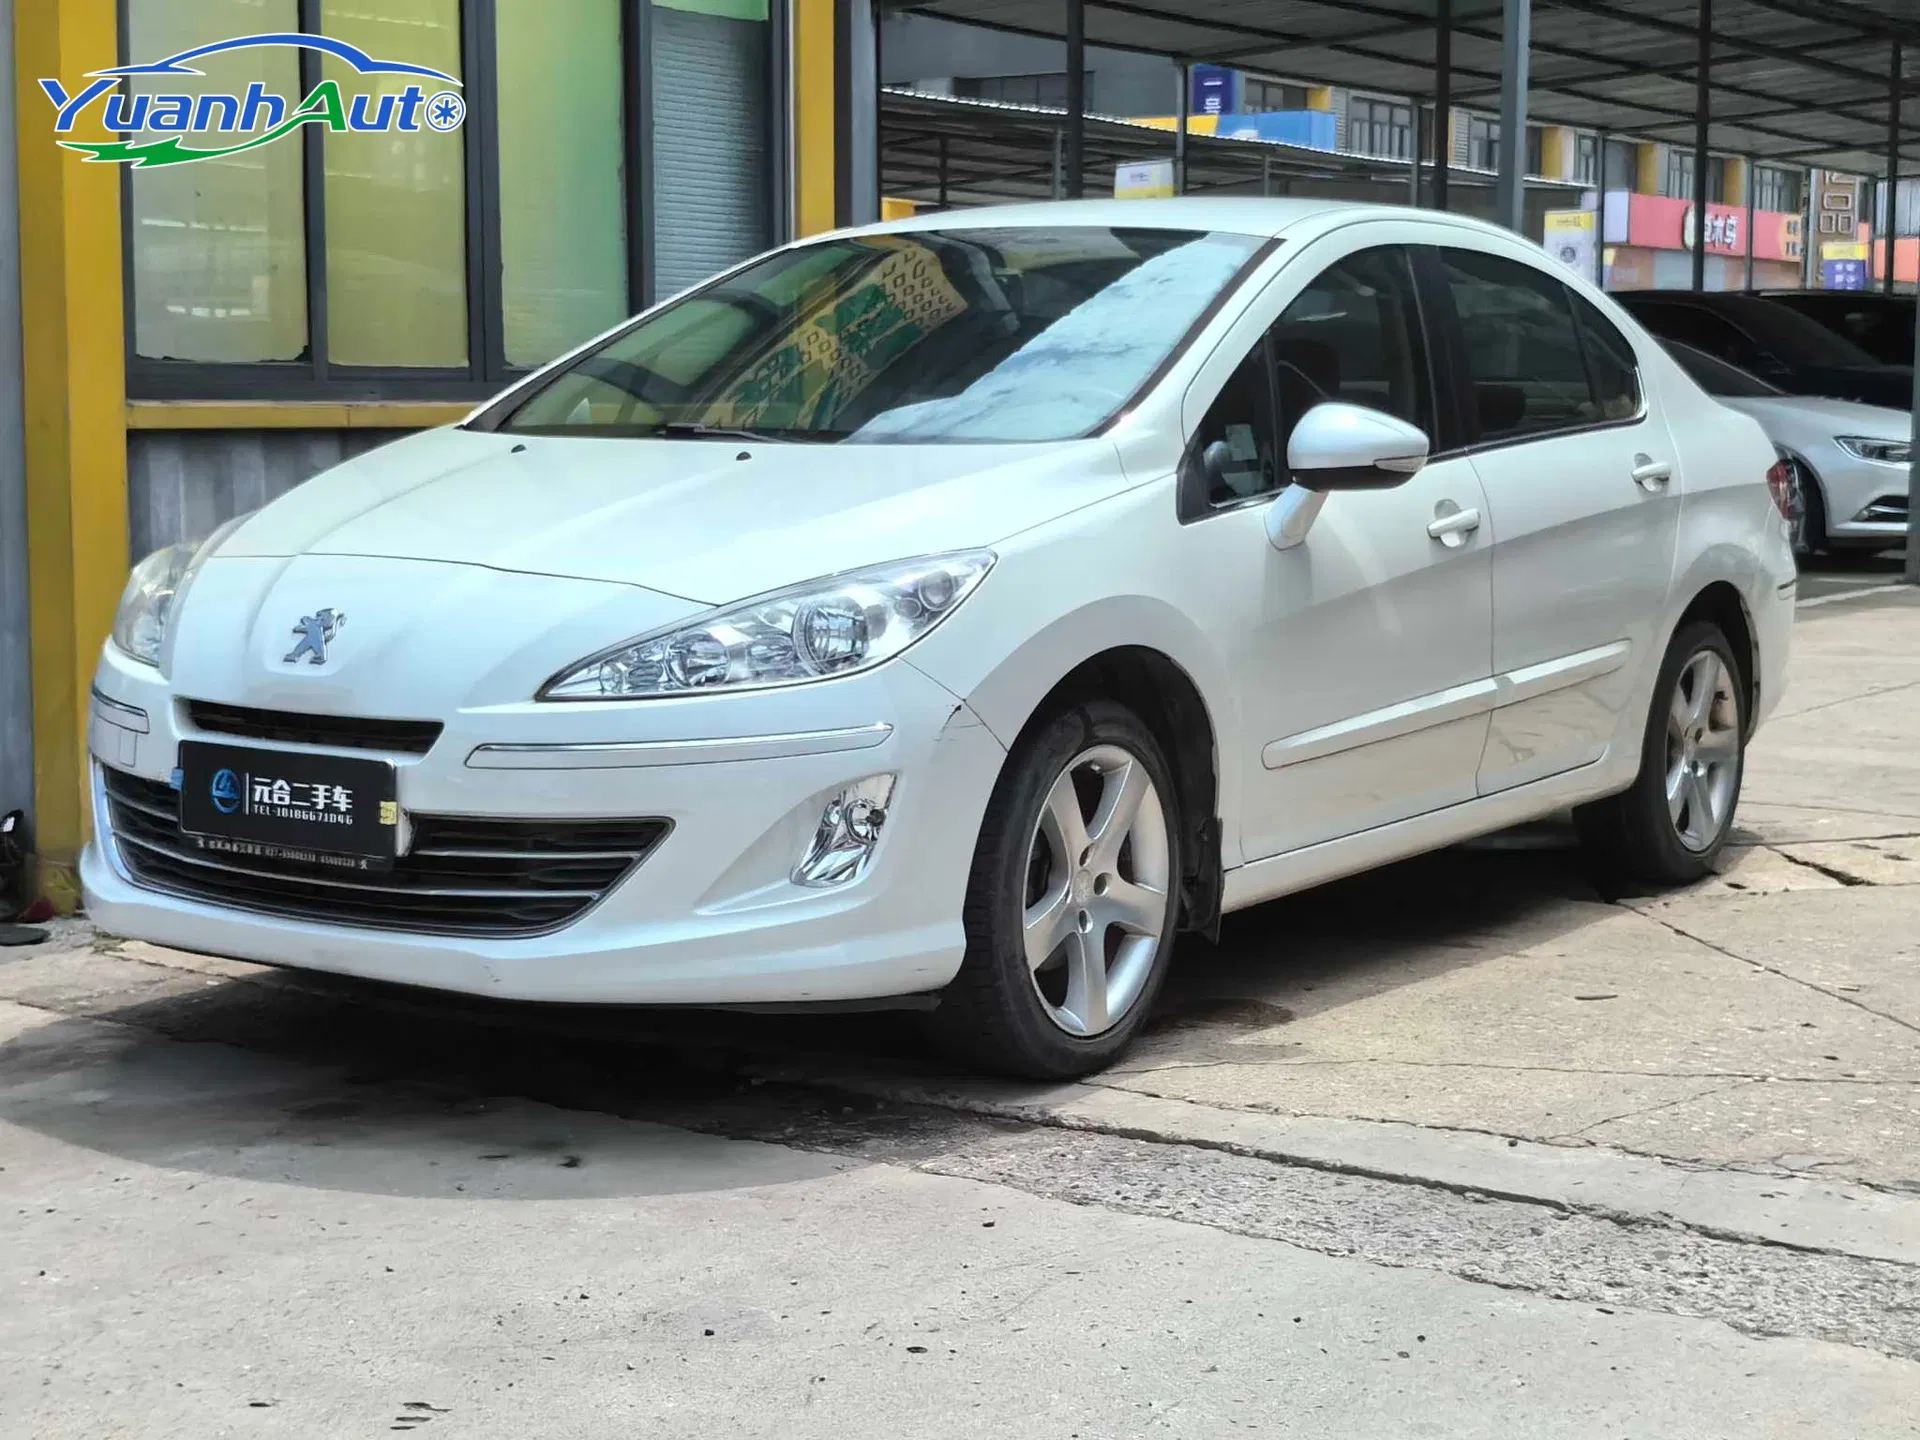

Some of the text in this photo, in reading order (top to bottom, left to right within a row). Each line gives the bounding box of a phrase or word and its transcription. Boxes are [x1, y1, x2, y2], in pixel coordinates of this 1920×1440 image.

[253, 776, 354, 812] 元合二手车
